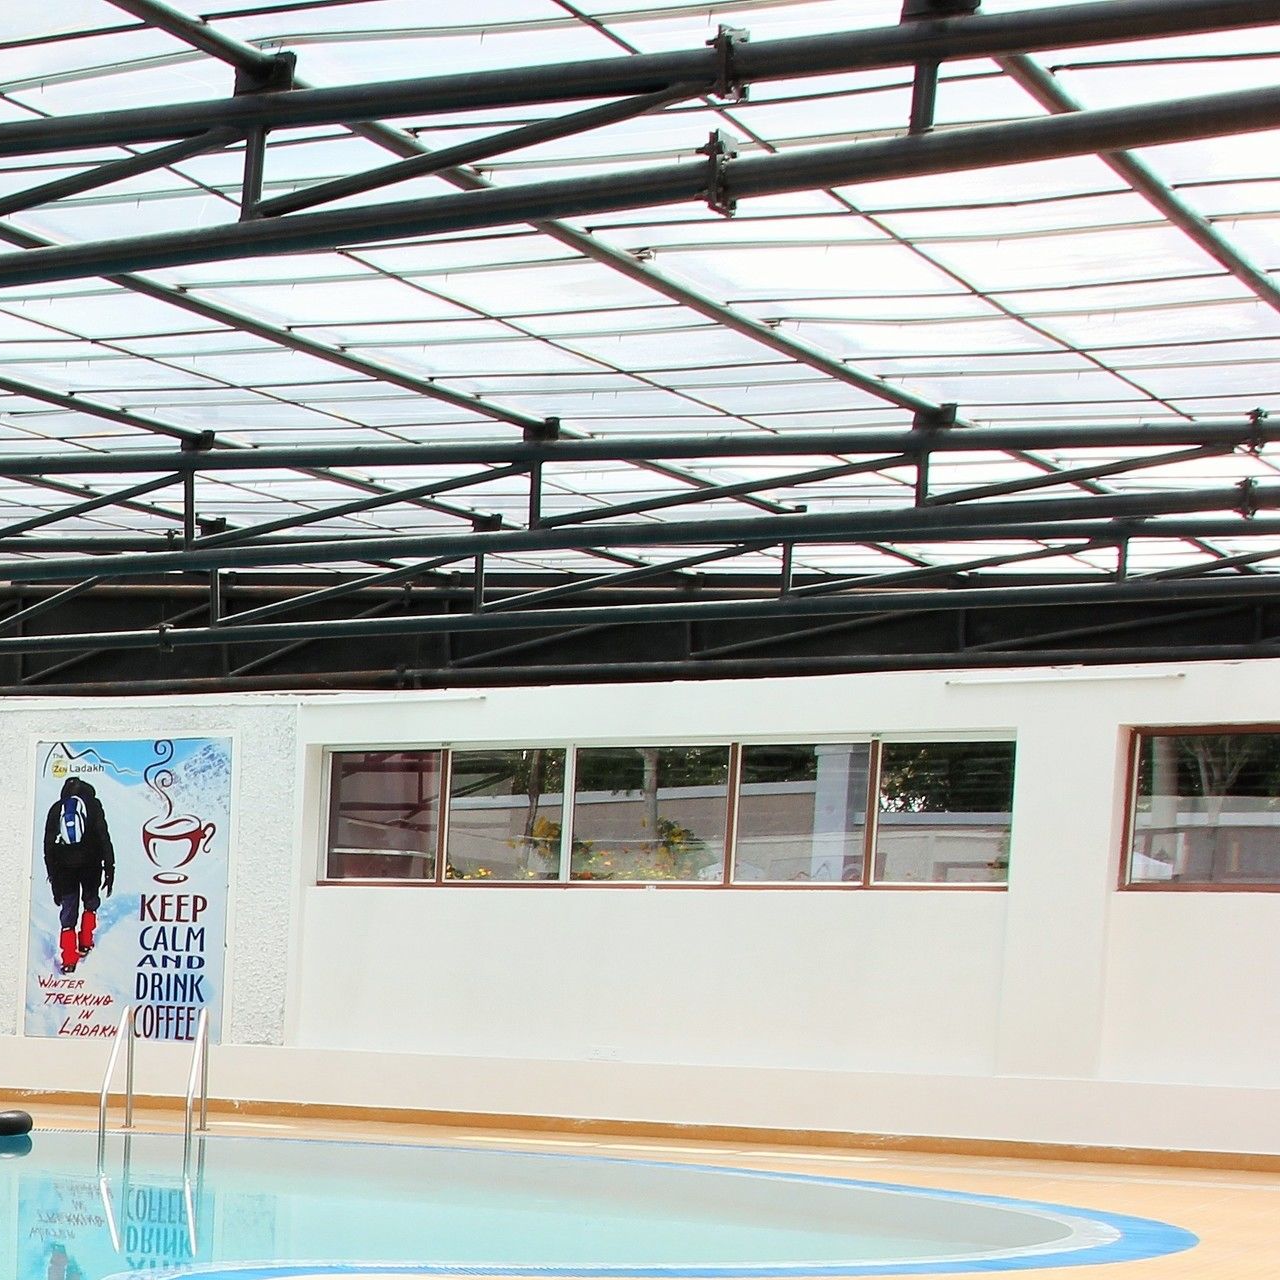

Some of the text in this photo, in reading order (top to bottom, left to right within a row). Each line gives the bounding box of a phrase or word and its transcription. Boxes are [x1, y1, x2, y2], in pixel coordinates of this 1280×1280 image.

[69, 763, 105, 773] Ladakh
[139, 893, 208, 922] KEEP
[139, 925, 205, 952] CALM
[136, 953, 205, 970] AND
[38, 973, 85, 989] WINTER
[135, 971, 205, 1003] DRINK
[44, 993, 113, 1006] TREKKING
[78, 1009, 94, 1020] IN
[58, 1016, 119, 1038] LADAKH
